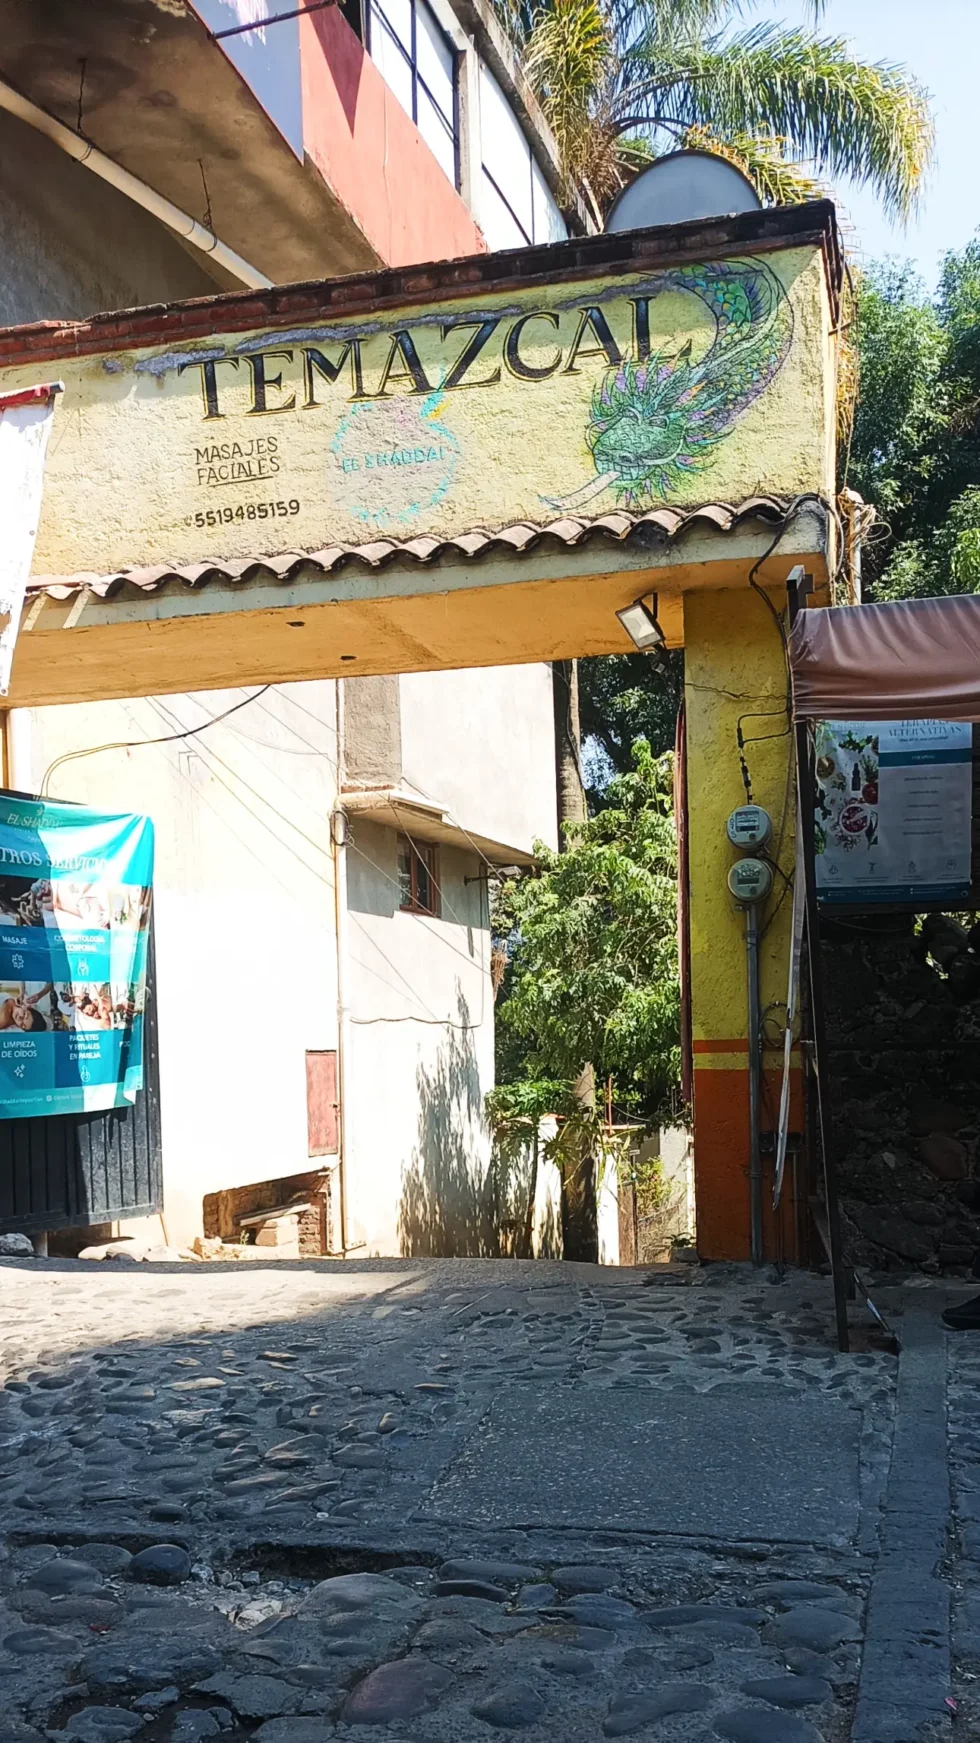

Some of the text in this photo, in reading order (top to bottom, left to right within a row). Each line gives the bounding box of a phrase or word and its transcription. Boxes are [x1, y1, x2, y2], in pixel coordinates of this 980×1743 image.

[179, 296, 692, 421] TEMAZCAL
[195, 436, 278, 465] MASAJES
[342, 446, 446, 473] EL SHADDAI
[197, 456, 281, 486] FACIALES
[194, 499, 301, 528] 5519485159
[2, 935, 28, 945] MASAJE
[1, 1050, 13, 1058] DE
[3, 1041, 36, 1049] LIMPIEZA
